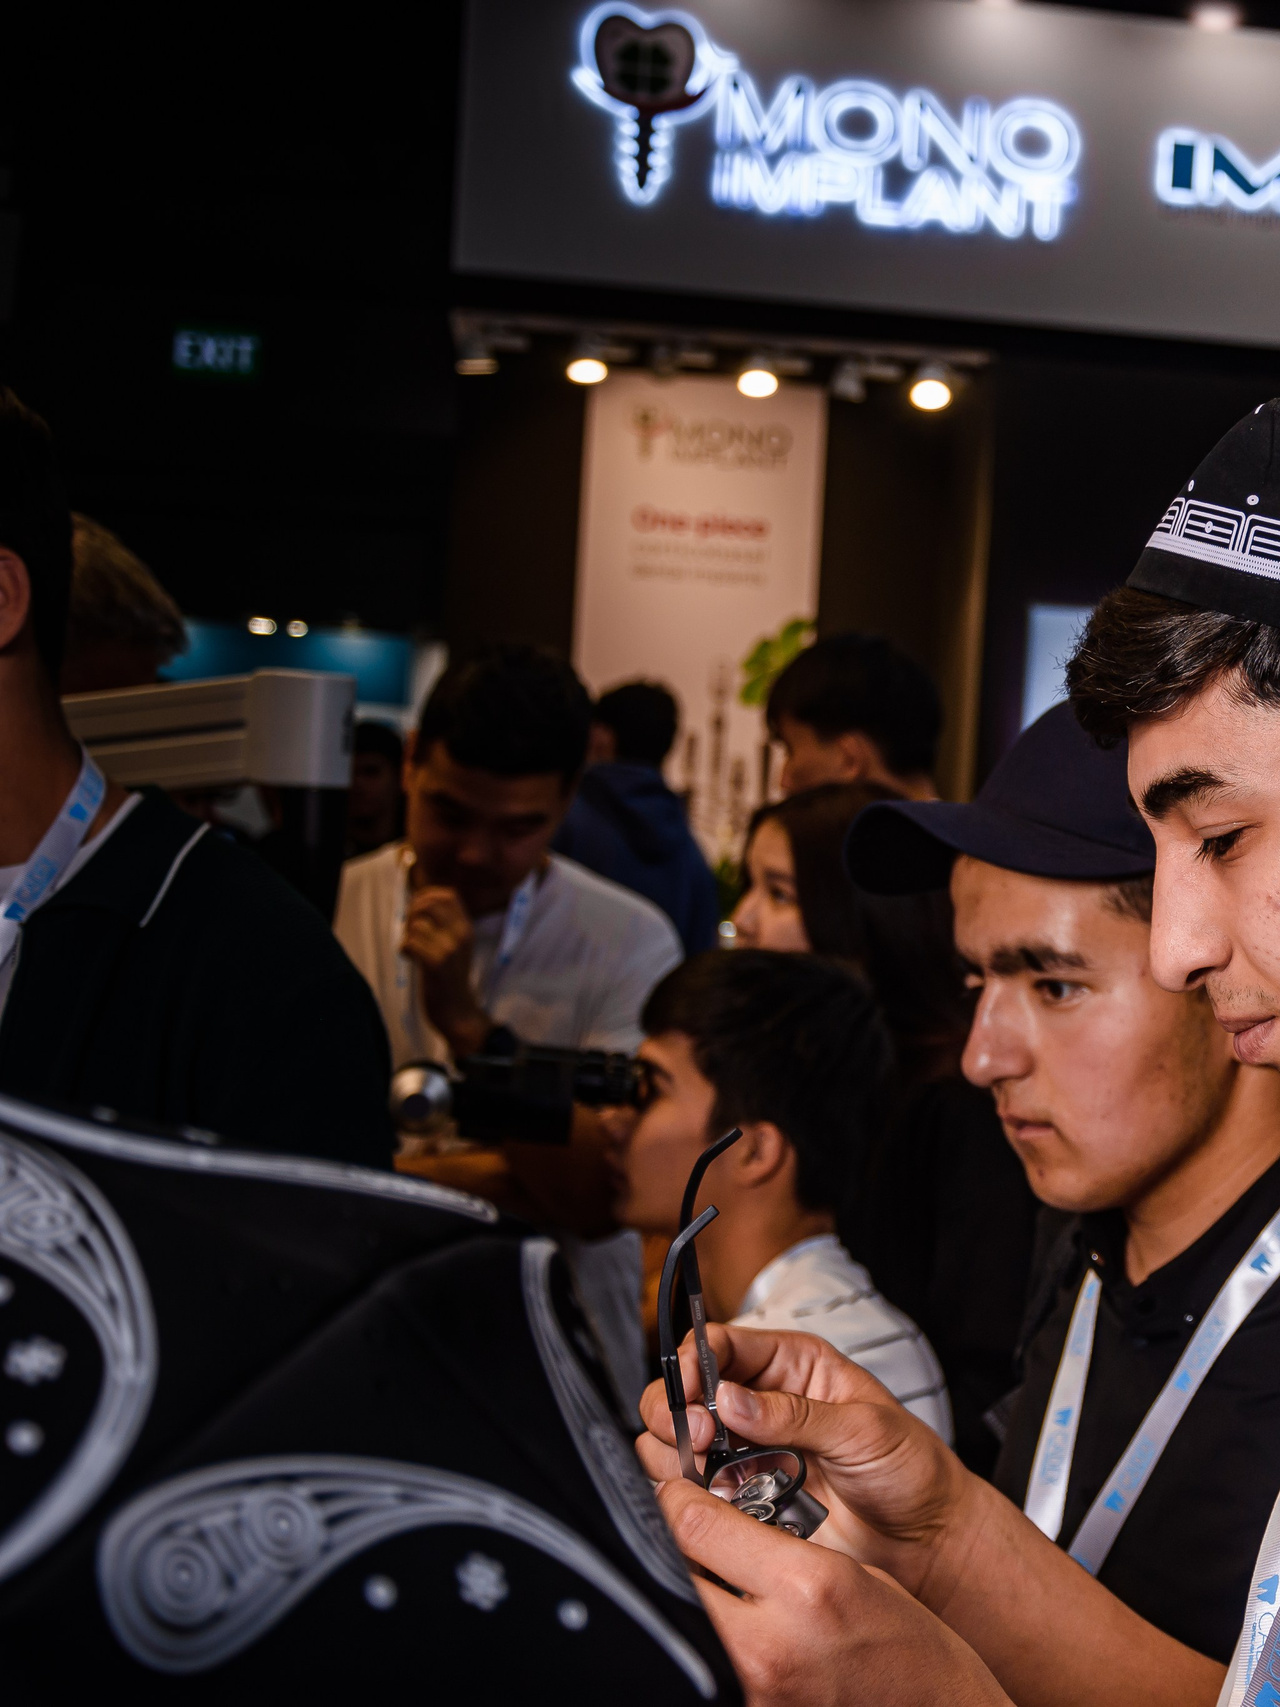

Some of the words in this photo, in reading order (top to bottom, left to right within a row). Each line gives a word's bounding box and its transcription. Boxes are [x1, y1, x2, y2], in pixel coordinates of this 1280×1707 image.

[715, 74, 1081, 186] MONO
[712, 150, 1077, 241] IMPLANT
[172, 330, 262, 373] EXIT
